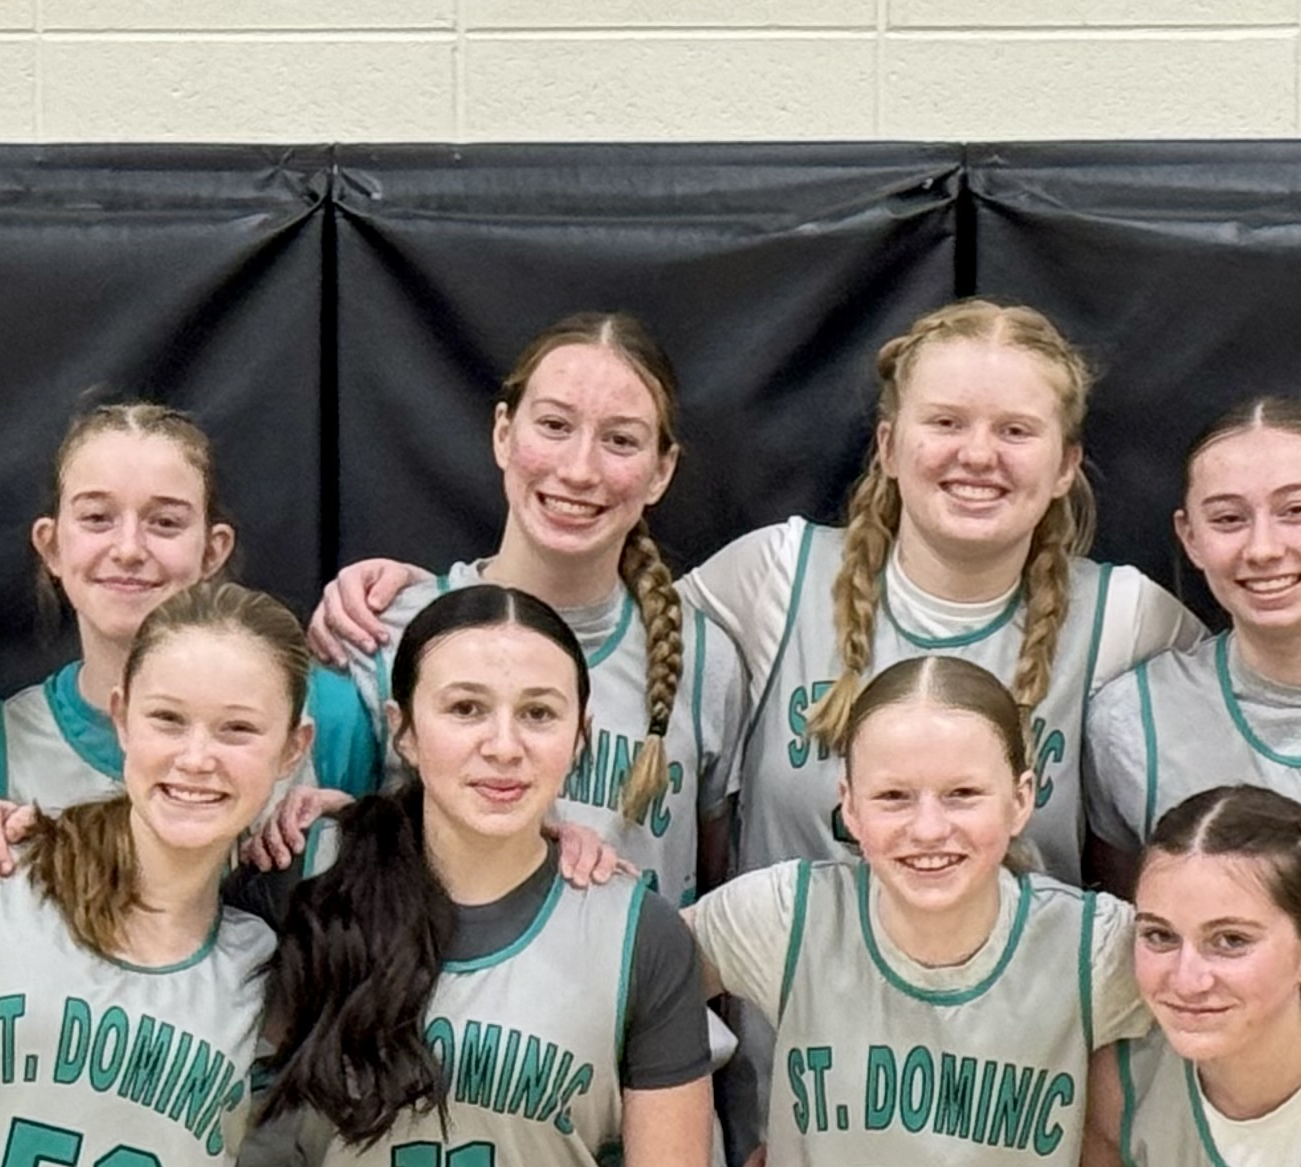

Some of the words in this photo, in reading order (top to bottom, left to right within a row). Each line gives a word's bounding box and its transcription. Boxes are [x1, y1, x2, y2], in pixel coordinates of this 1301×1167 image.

[556, 728, 685, 839] MINC
[53, 996, 249, 1157] DOMINIC
[424, 1016, 595, 1136] OMINIC
[787, 1045, 850, 1135] ST.
[863, 1044, 1076, 1157] DOMINIC
